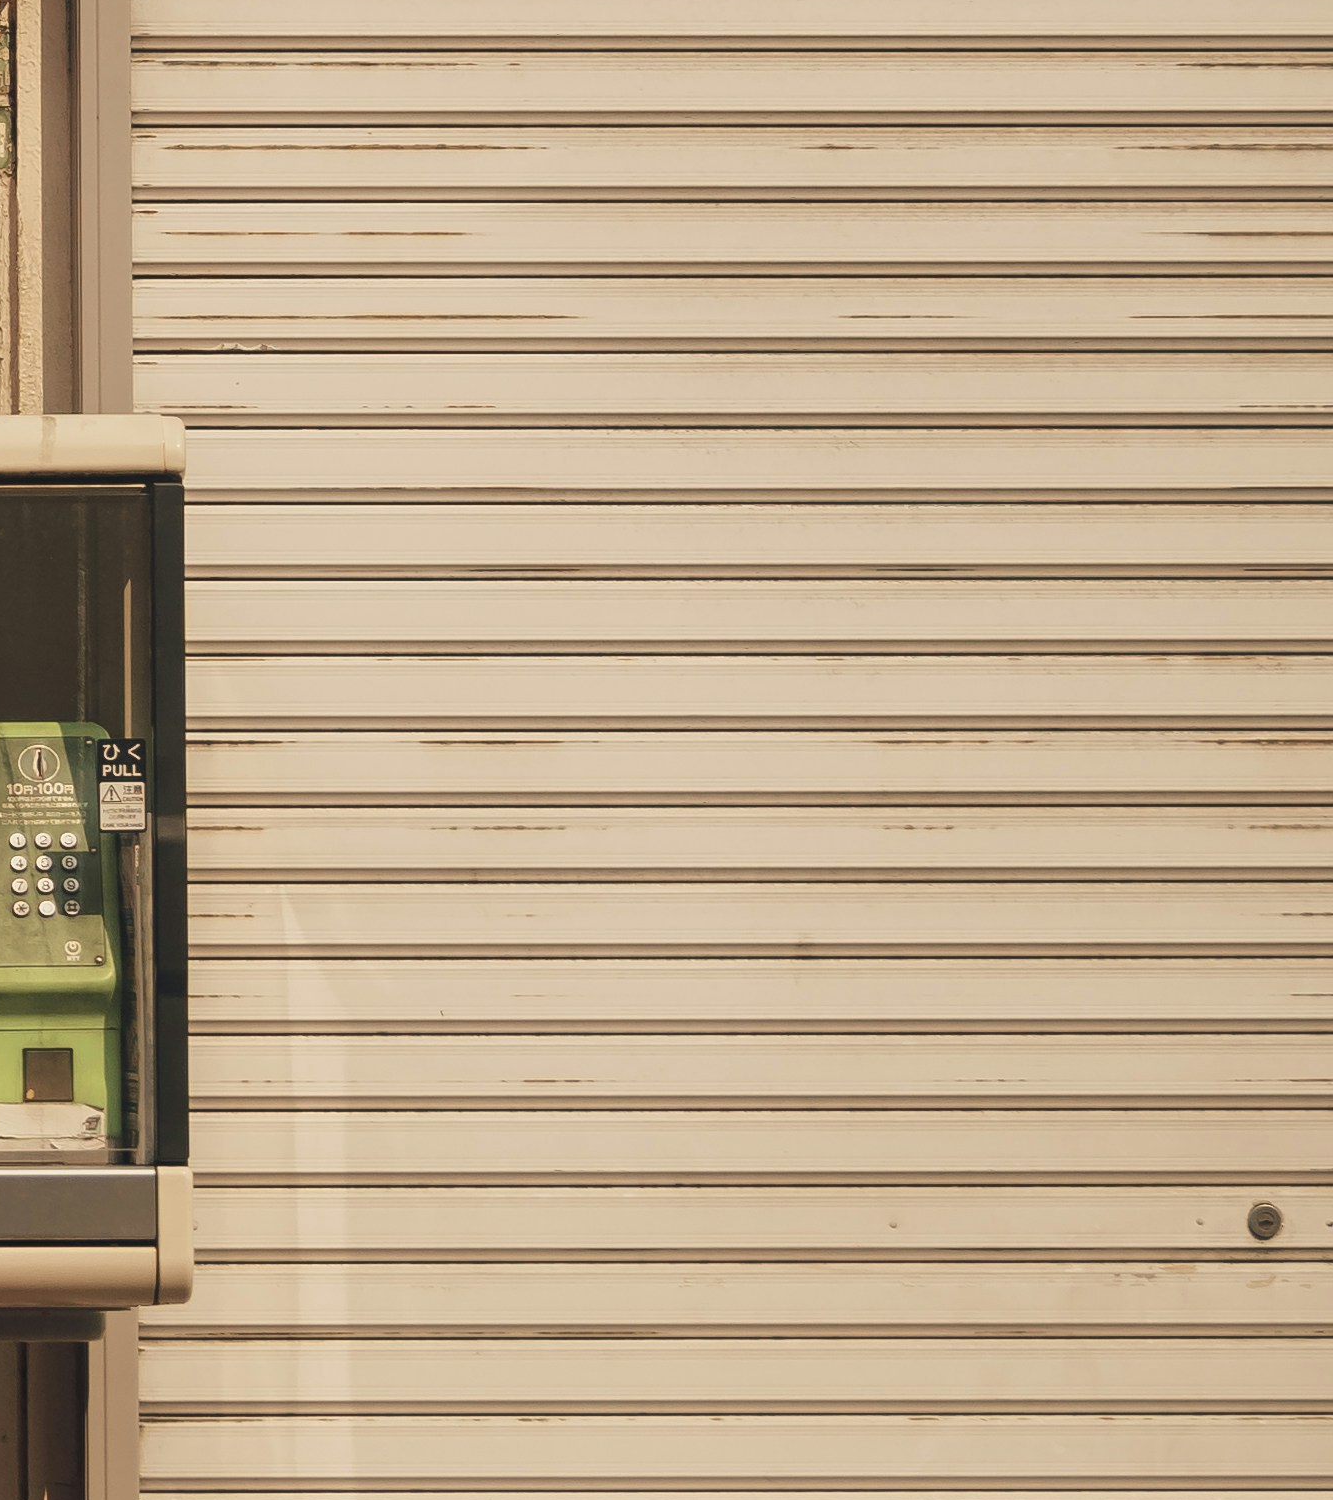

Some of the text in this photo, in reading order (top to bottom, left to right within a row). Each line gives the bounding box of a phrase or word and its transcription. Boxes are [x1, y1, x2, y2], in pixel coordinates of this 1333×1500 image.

[102, 743, 141, 761] ひく
[102, 764, 142, 777] PULL
[6, 783, 74, 795] 10円・100円
[15, 836, 21, 845] 1
[39, 836, 47, 845] 2
[15, 858, 23, 867] 4
[65, 858, 73, 867] 6
[16, 881, 75, 890] 7 8 9
